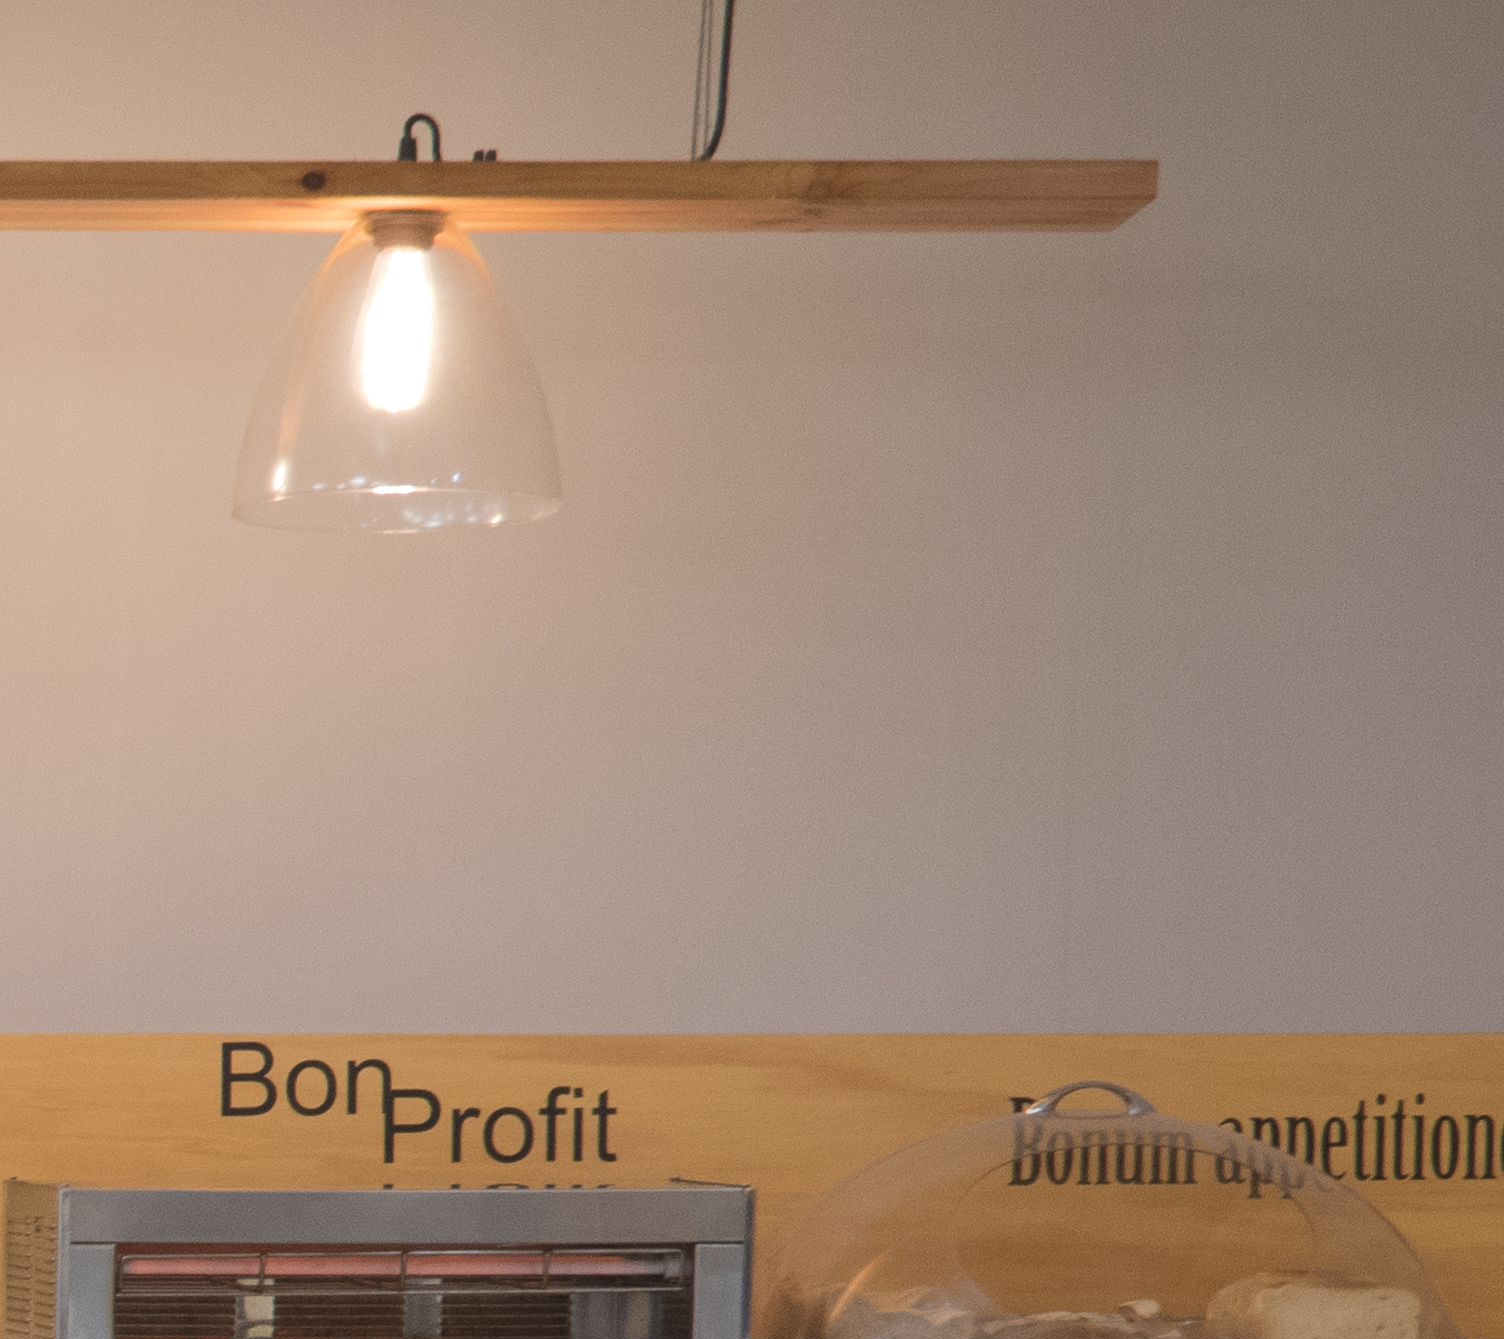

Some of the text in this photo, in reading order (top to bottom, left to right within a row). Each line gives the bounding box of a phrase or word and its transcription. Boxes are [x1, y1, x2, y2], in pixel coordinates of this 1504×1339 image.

[220, 1041, 392, 1118] Bon
[382, 1086, 619, 1165] Profit
[1007, 1092, 1504, 1200] Bonum appetition
